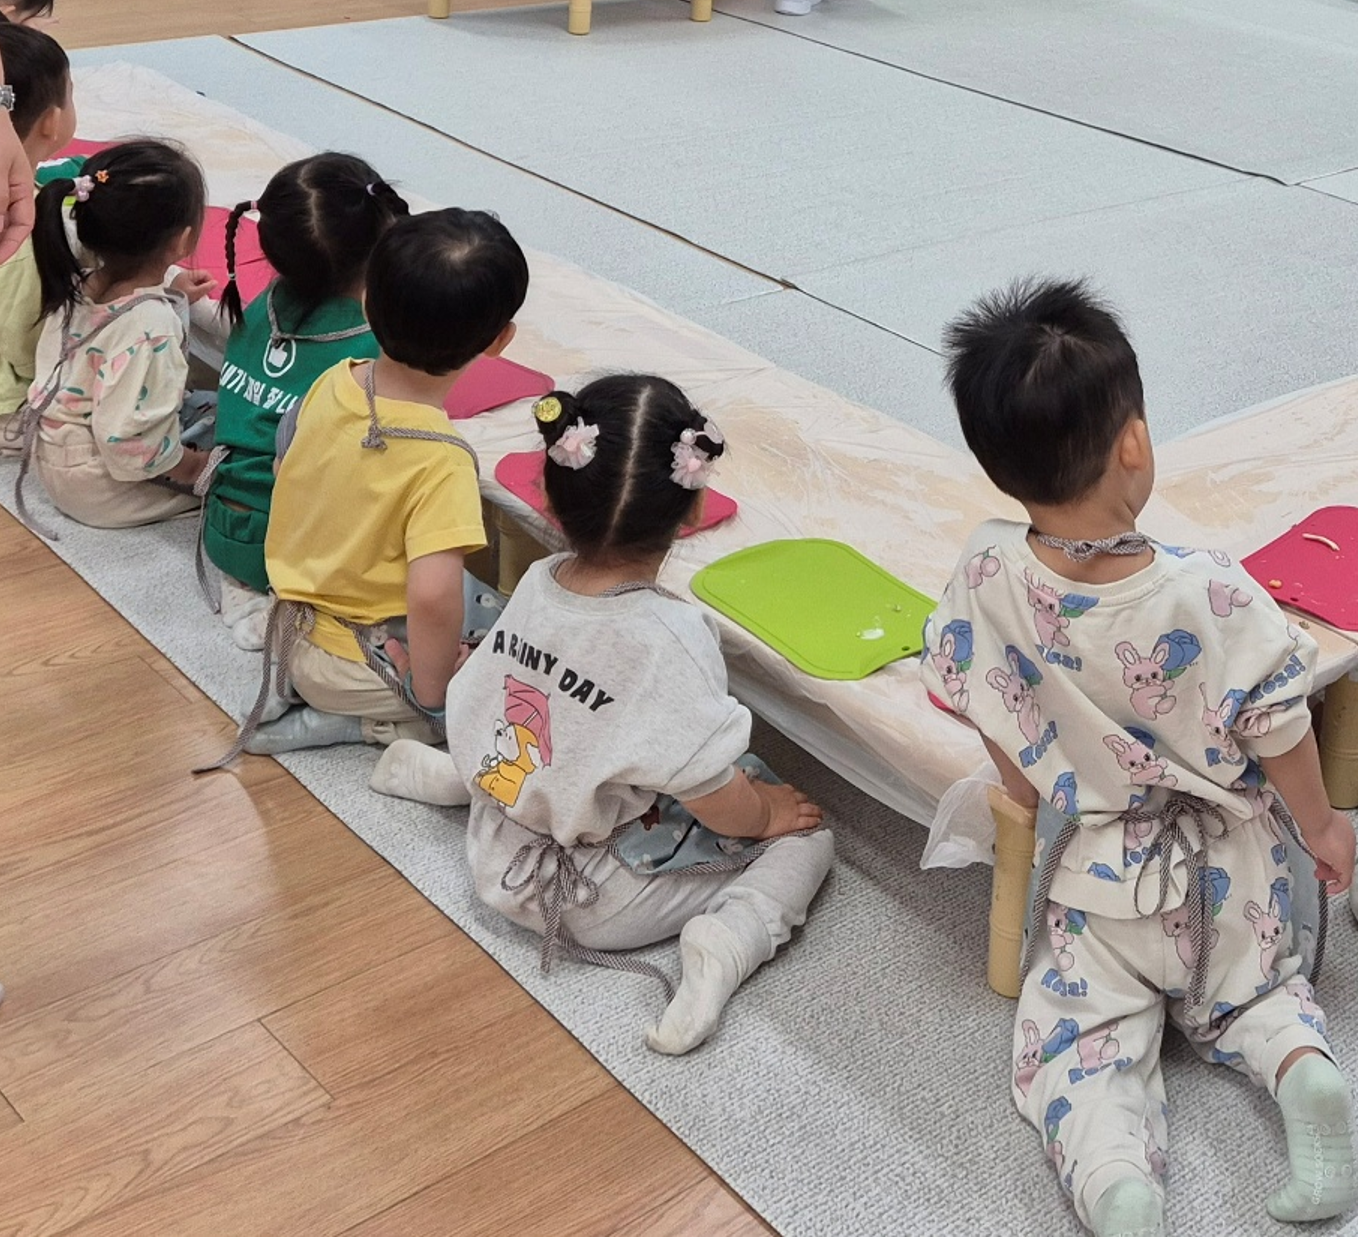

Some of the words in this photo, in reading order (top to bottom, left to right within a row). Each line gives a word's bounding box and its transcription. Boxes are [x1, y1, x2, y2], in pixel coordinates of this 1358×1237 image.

[493, 630, 505, 654] A
[508, 633, 559, 676] RINY
[558, 667, 615, 713] DAY
